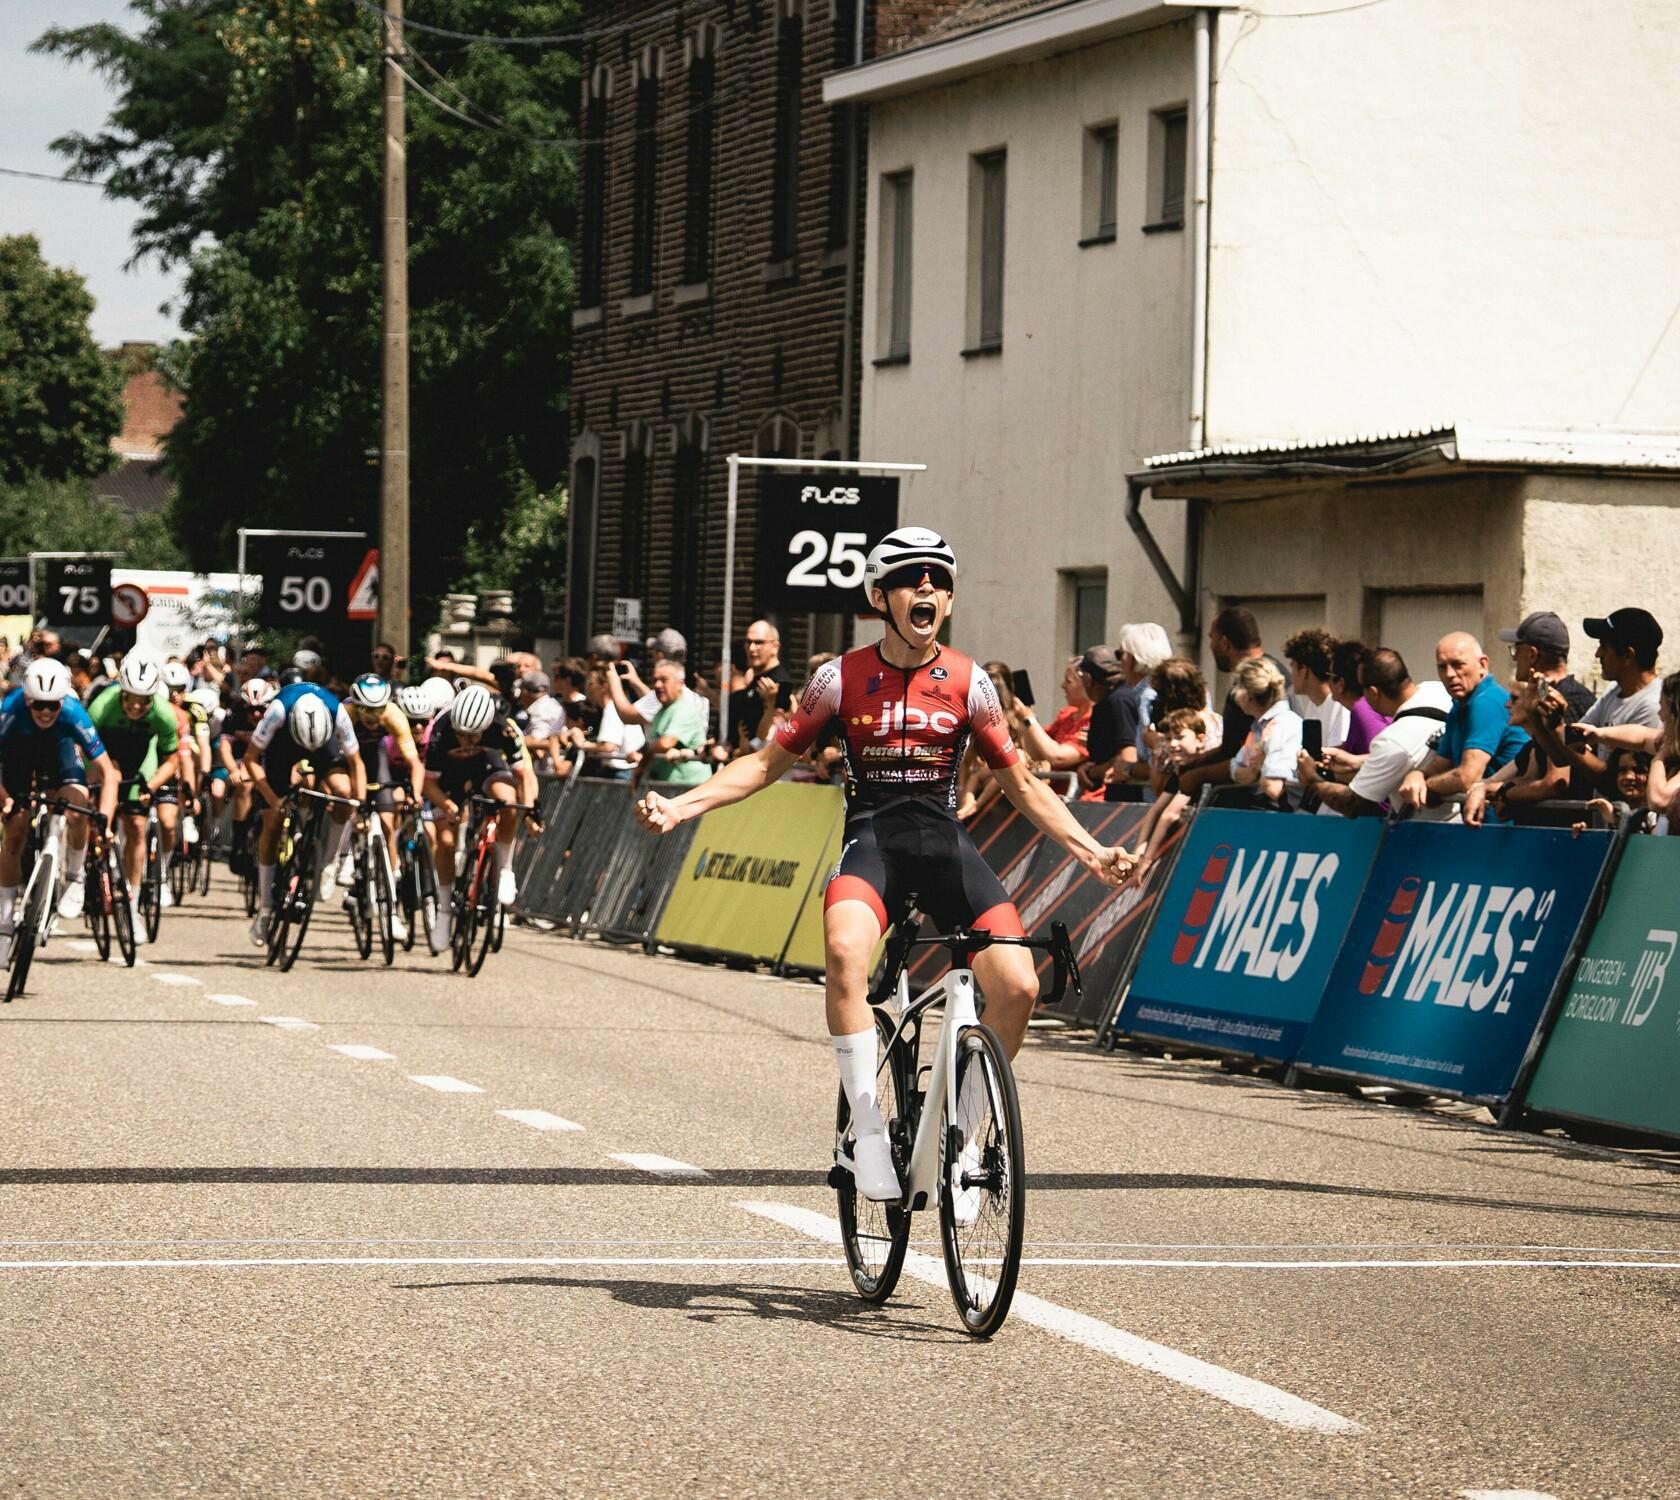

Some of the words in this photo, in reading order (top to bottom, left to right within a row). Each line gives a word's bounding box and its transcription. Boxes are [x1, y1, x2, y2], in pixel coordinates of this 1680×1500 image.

[785, 529, 868, 589] 25
[59, 585, 100, 615] 75
[279, 576, 332, 612] 50
[873, 701, 959, 737] jbc
[1193, 848, 1340, 982] MAES
[1381, 881, 1536, 1012] MAES
[1493, 888, 1556, 1014] PILS
[1565, 993, 1620, 1022] BORGLOON
